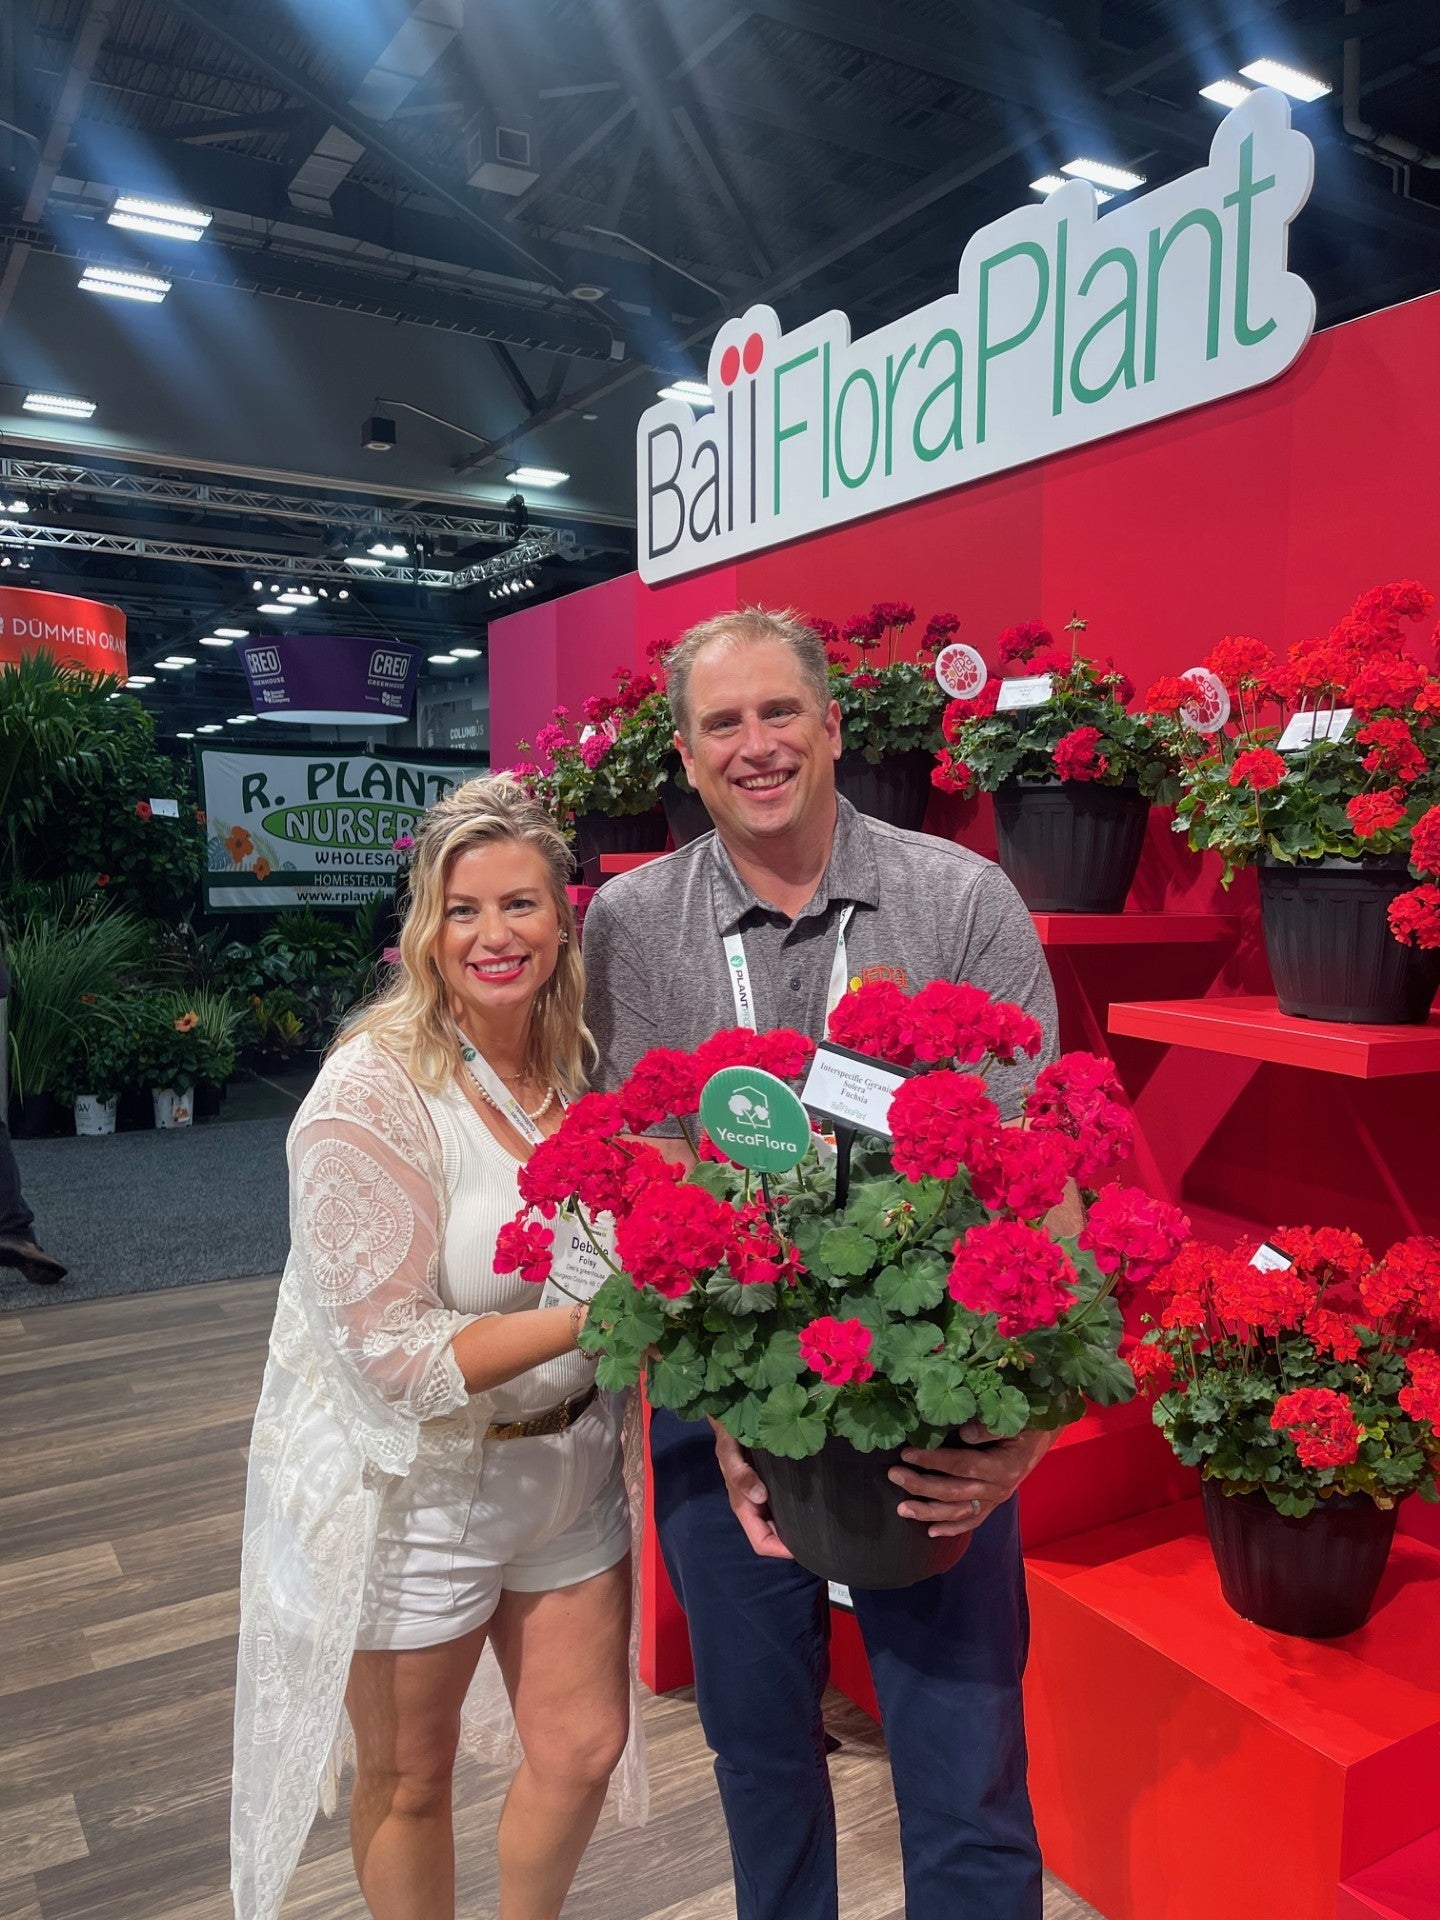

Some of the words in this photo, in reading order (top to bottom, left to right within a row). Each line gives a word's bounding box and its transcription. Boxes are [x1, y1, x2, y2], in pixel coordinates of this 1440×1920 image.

[12, 617, 96, 646] DÜMMEN
[247, 651, 278, 674] CREO
[373, 653, 408, 677] CREO
[450, 724, 484, 740] COLUMBUS
[242, 772, 285, 814] R.
[307, 761, 463, 807] PLANT
[285, 807, 424, 848] NURSER
[314, 874, 388, 887] HOMESTEAD,
[820, 1062, 864, 1084] Interspecific
[840, 1088, 869, 1105] Fuchsia
[716, 1126, 798, 1153] YecaFlora
[578, 1255, 597, 1269] Foisy
